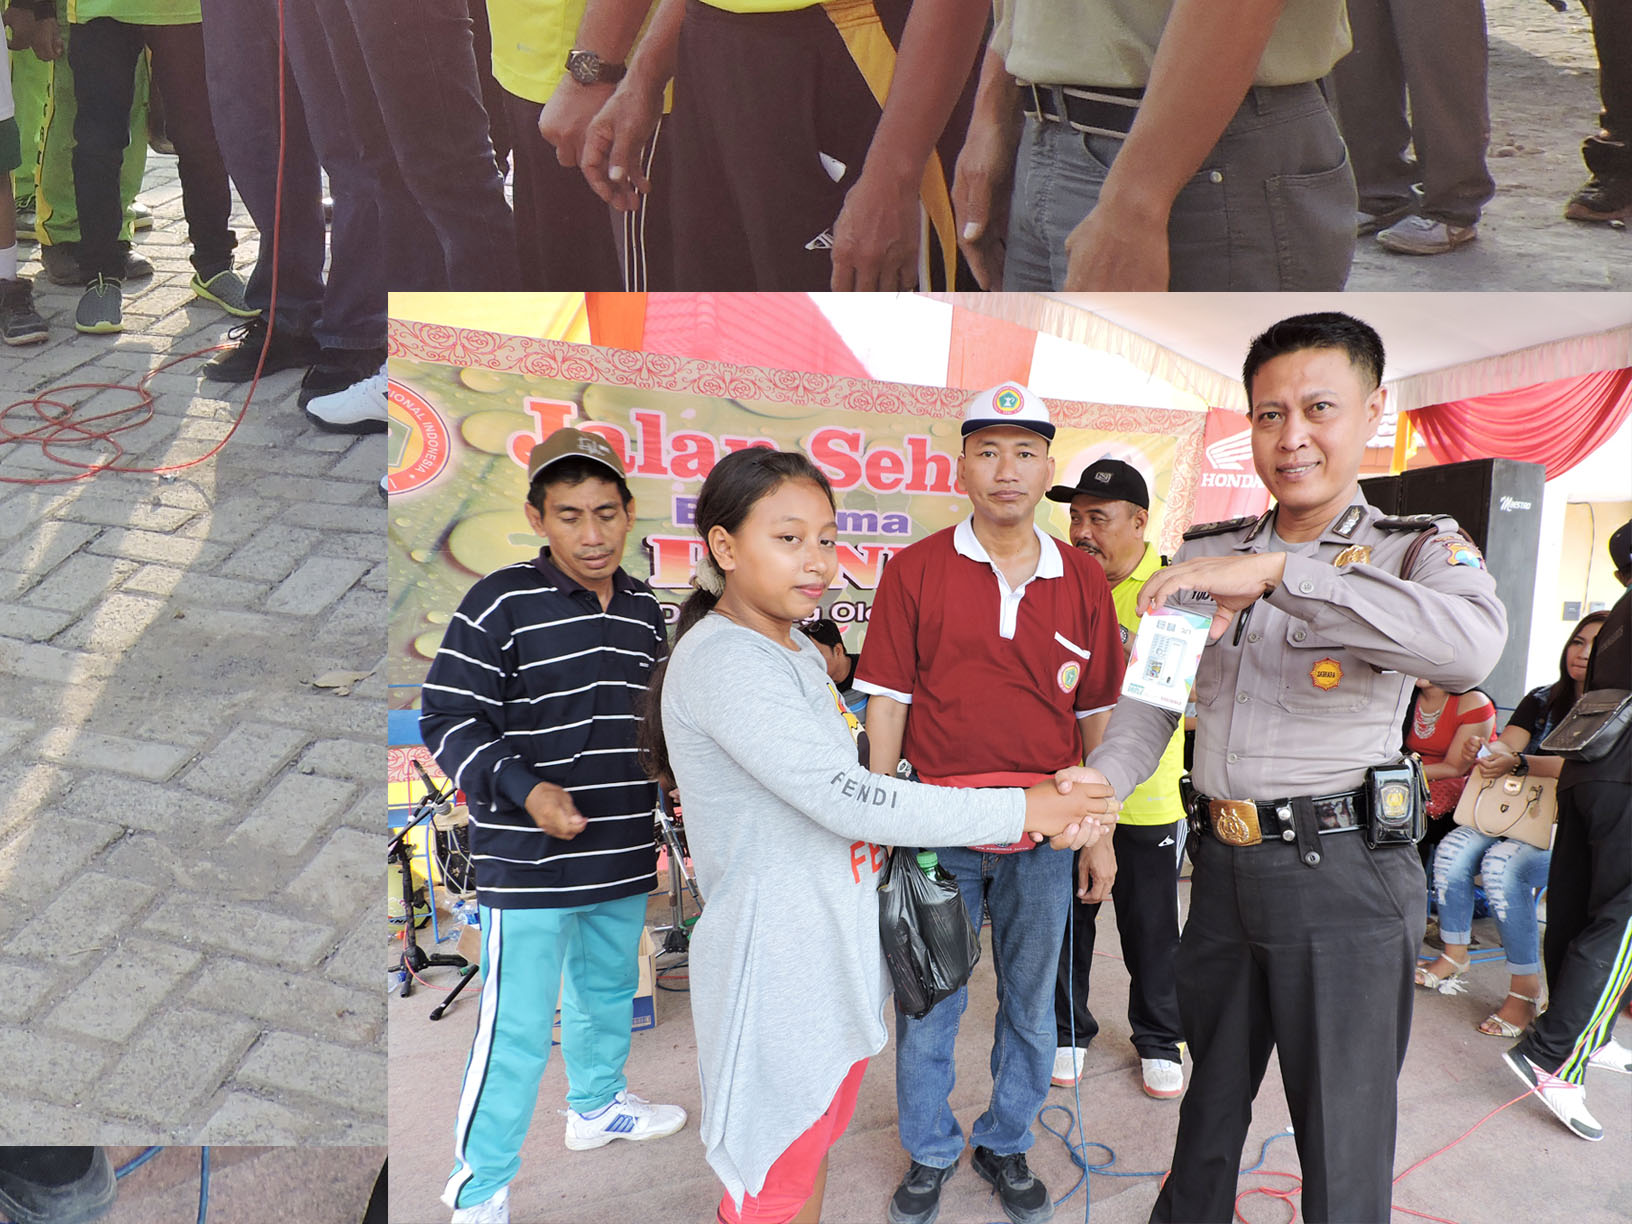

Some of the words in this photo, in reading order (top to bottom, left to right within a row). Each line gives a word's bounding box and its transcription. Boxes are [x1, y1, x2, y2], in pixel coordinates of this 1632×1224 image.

[387, 388, 426, 421] IONAL
[414, 421, 440, 473] INDONESIA
[806, 426, 968, 497] Seh
[1201, 473, 1265, 489] HONDA
[830, 771, 898, 809] FENDI
